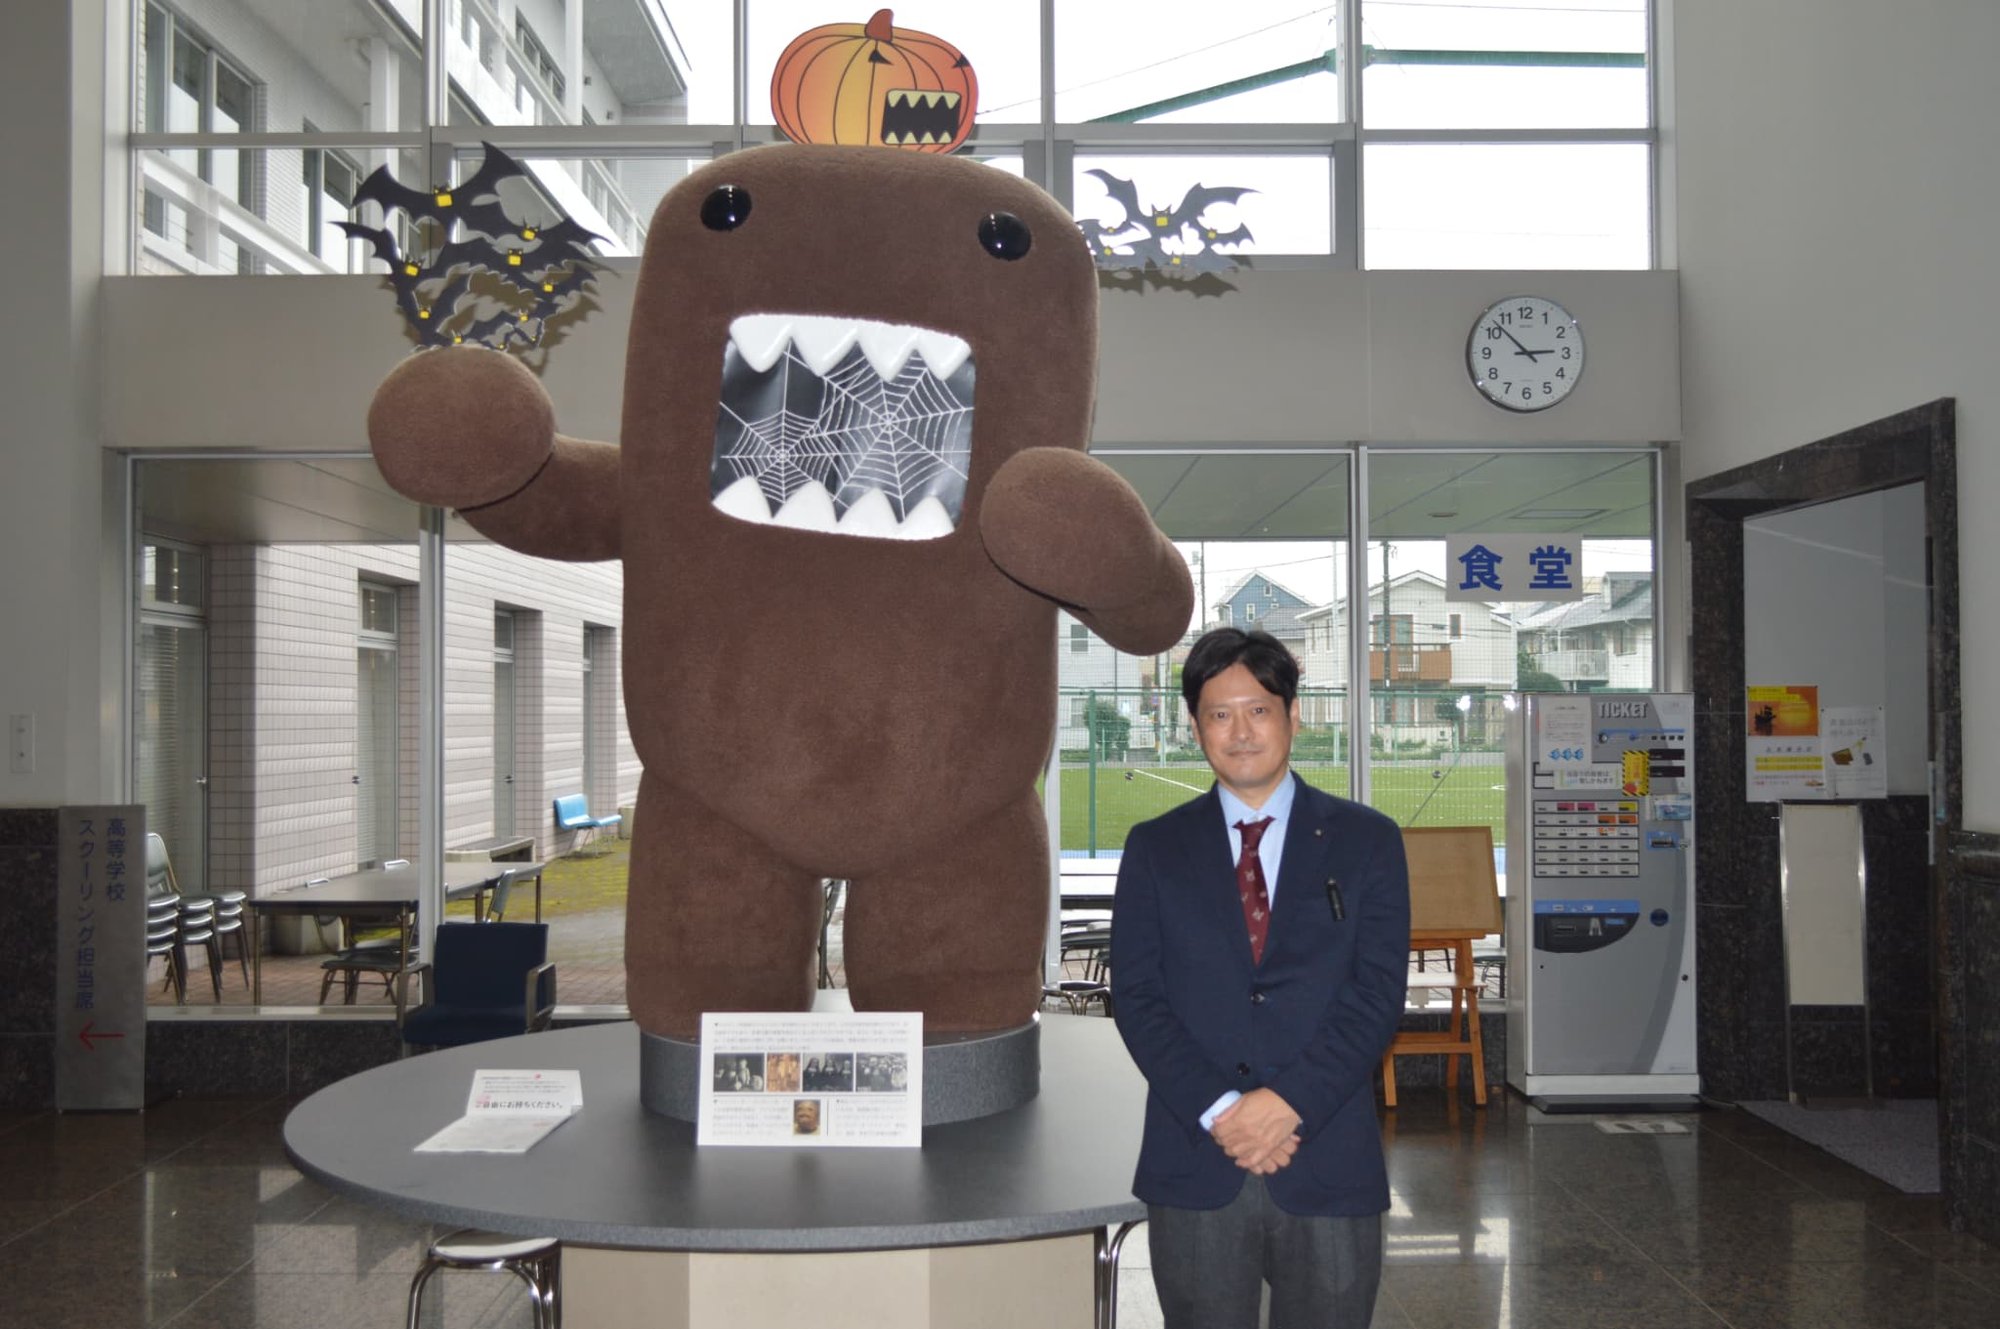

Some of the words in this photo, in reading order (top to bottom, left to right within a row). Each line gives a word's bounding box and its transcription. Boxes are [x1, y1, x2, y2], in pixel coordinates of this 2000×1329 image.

[1499, 312, 1512, 325] 11
[1517, 306, 1533, 320] 12
[1542, 312, 1549, 325] 1
[1486, 326, 1502, 340] 10
[1555, 326, 1566, 339] 2
[1481, 346, 1492, 360] 9
[1561, 346, 1571, 360] 3
[1488, 367, 1499, 380] 8
[1555, 366, 1566, 380] 4
[1502, 382, 1513, 395] 7
[1521, 387, 1532, 400] 6
[1543, 381, 1553, 395] 5
[1458, 544, 1573, 592] 食堂
[1597, 701, 1648, 719] TICKET
[106, 817, 126, 902] 高等学校
